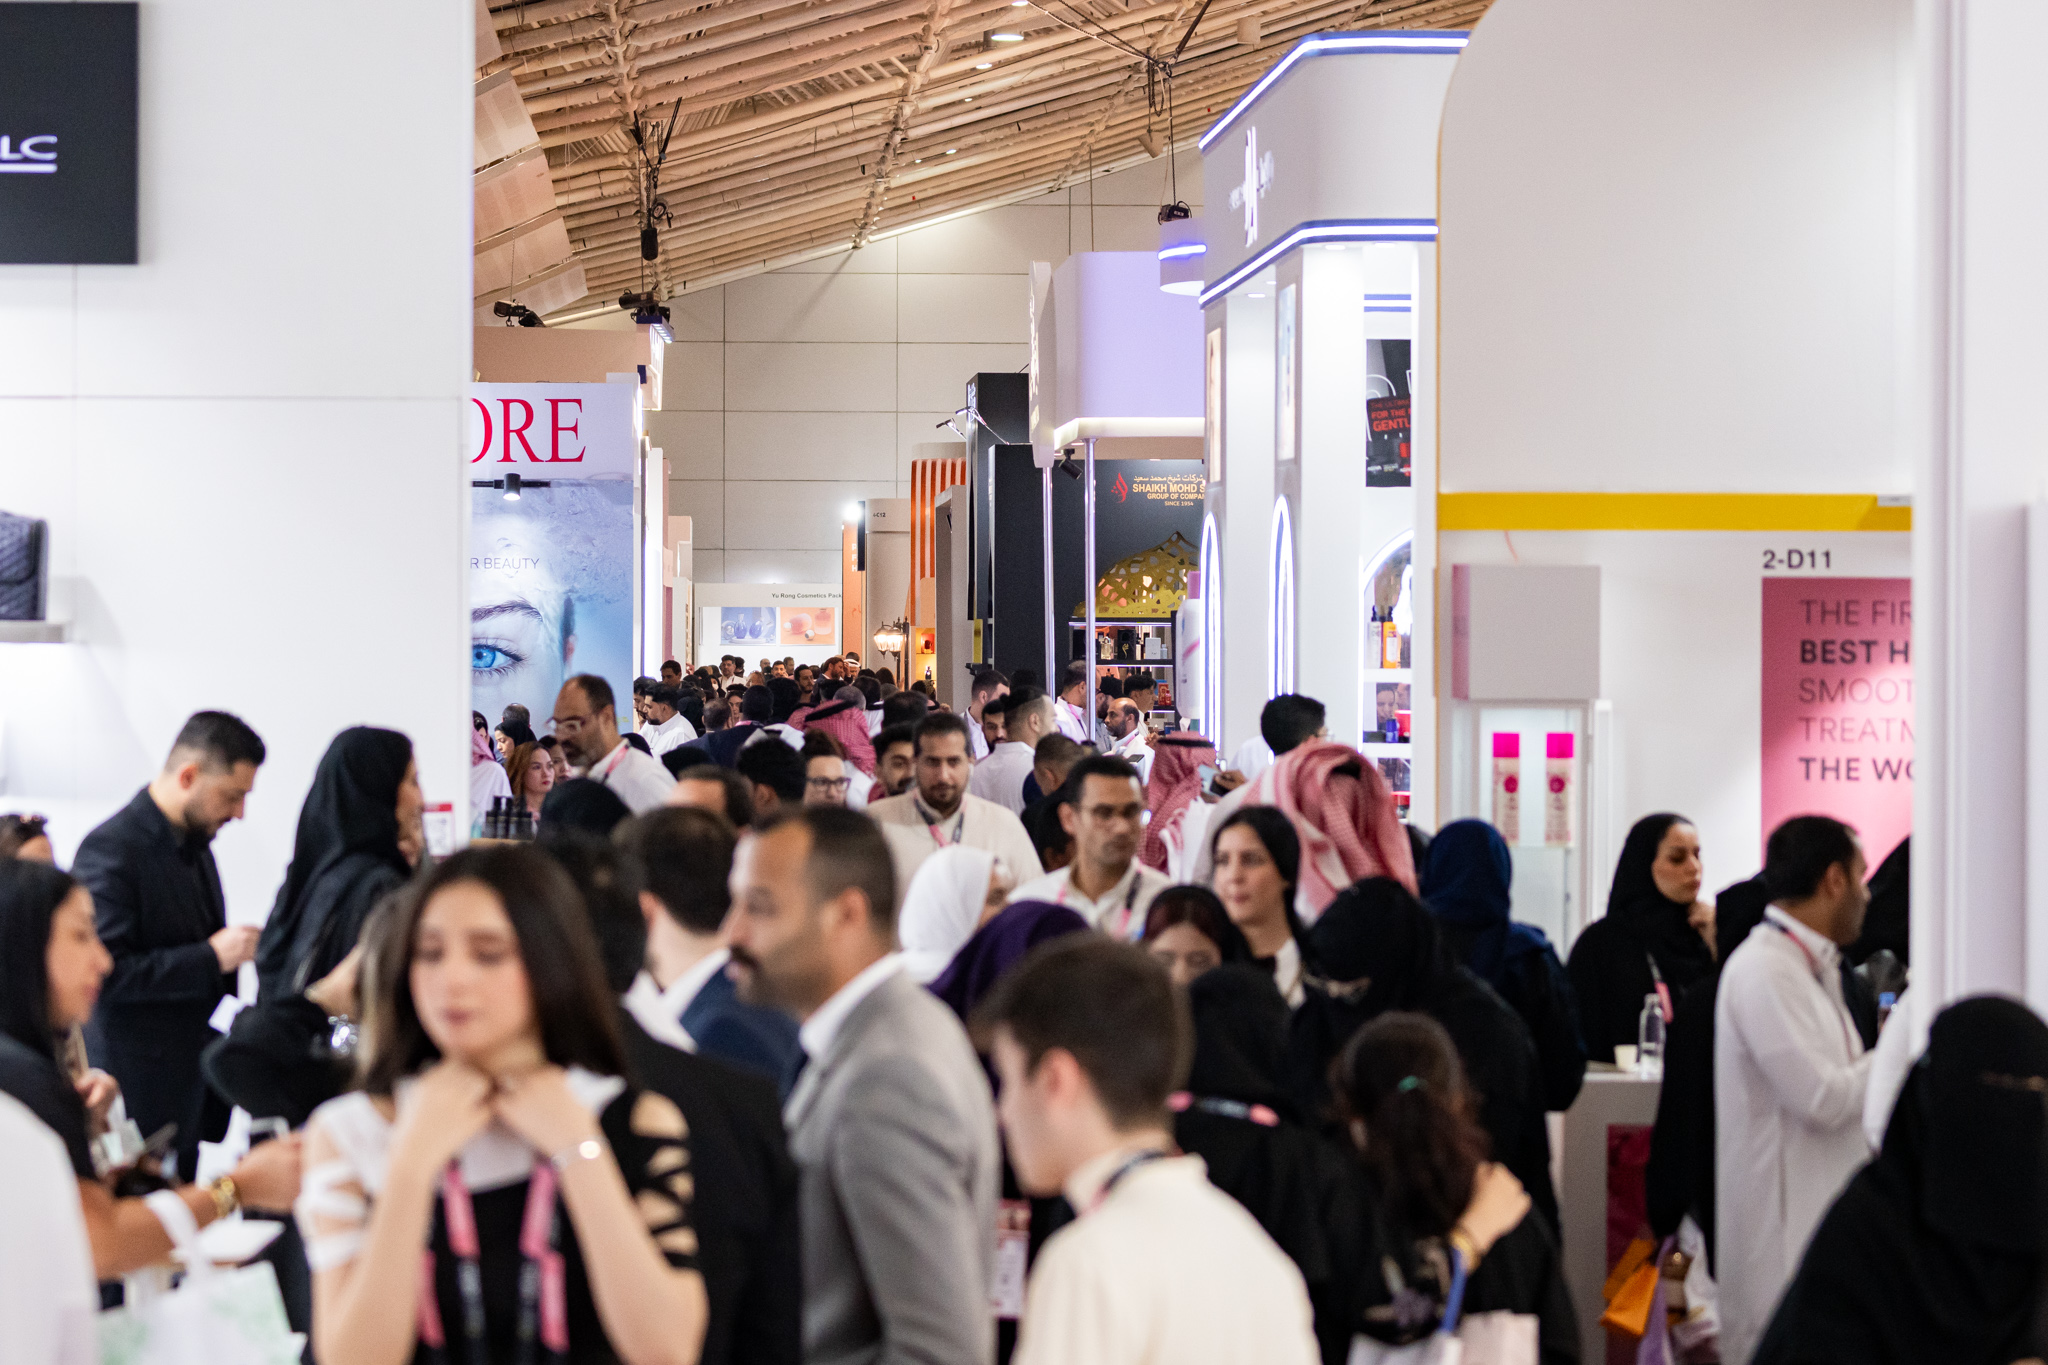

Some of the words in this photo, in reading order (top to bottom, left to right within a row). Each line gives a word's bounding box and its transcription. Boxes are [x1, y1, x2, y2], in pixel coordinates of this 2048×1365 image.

[1371, 410, 1388, 419] FOR
[1390, 408, 1405, 416] THE
[1167, 474, 1180, 485] شيخ
[1132, 483, 1167, 493] SHAIKH
[1169, 483, 1197, 493] MOHD
[484, 558, 539, 569] BEAUTY
[1762, 549, 1831, 569] 2-D11
[1799, 599, 1861, 626] THE
[1800, 639, 1878, 665] BEST
[1797, 757, 1861, 781] THE
[1871, 757, 1913, 781] W
